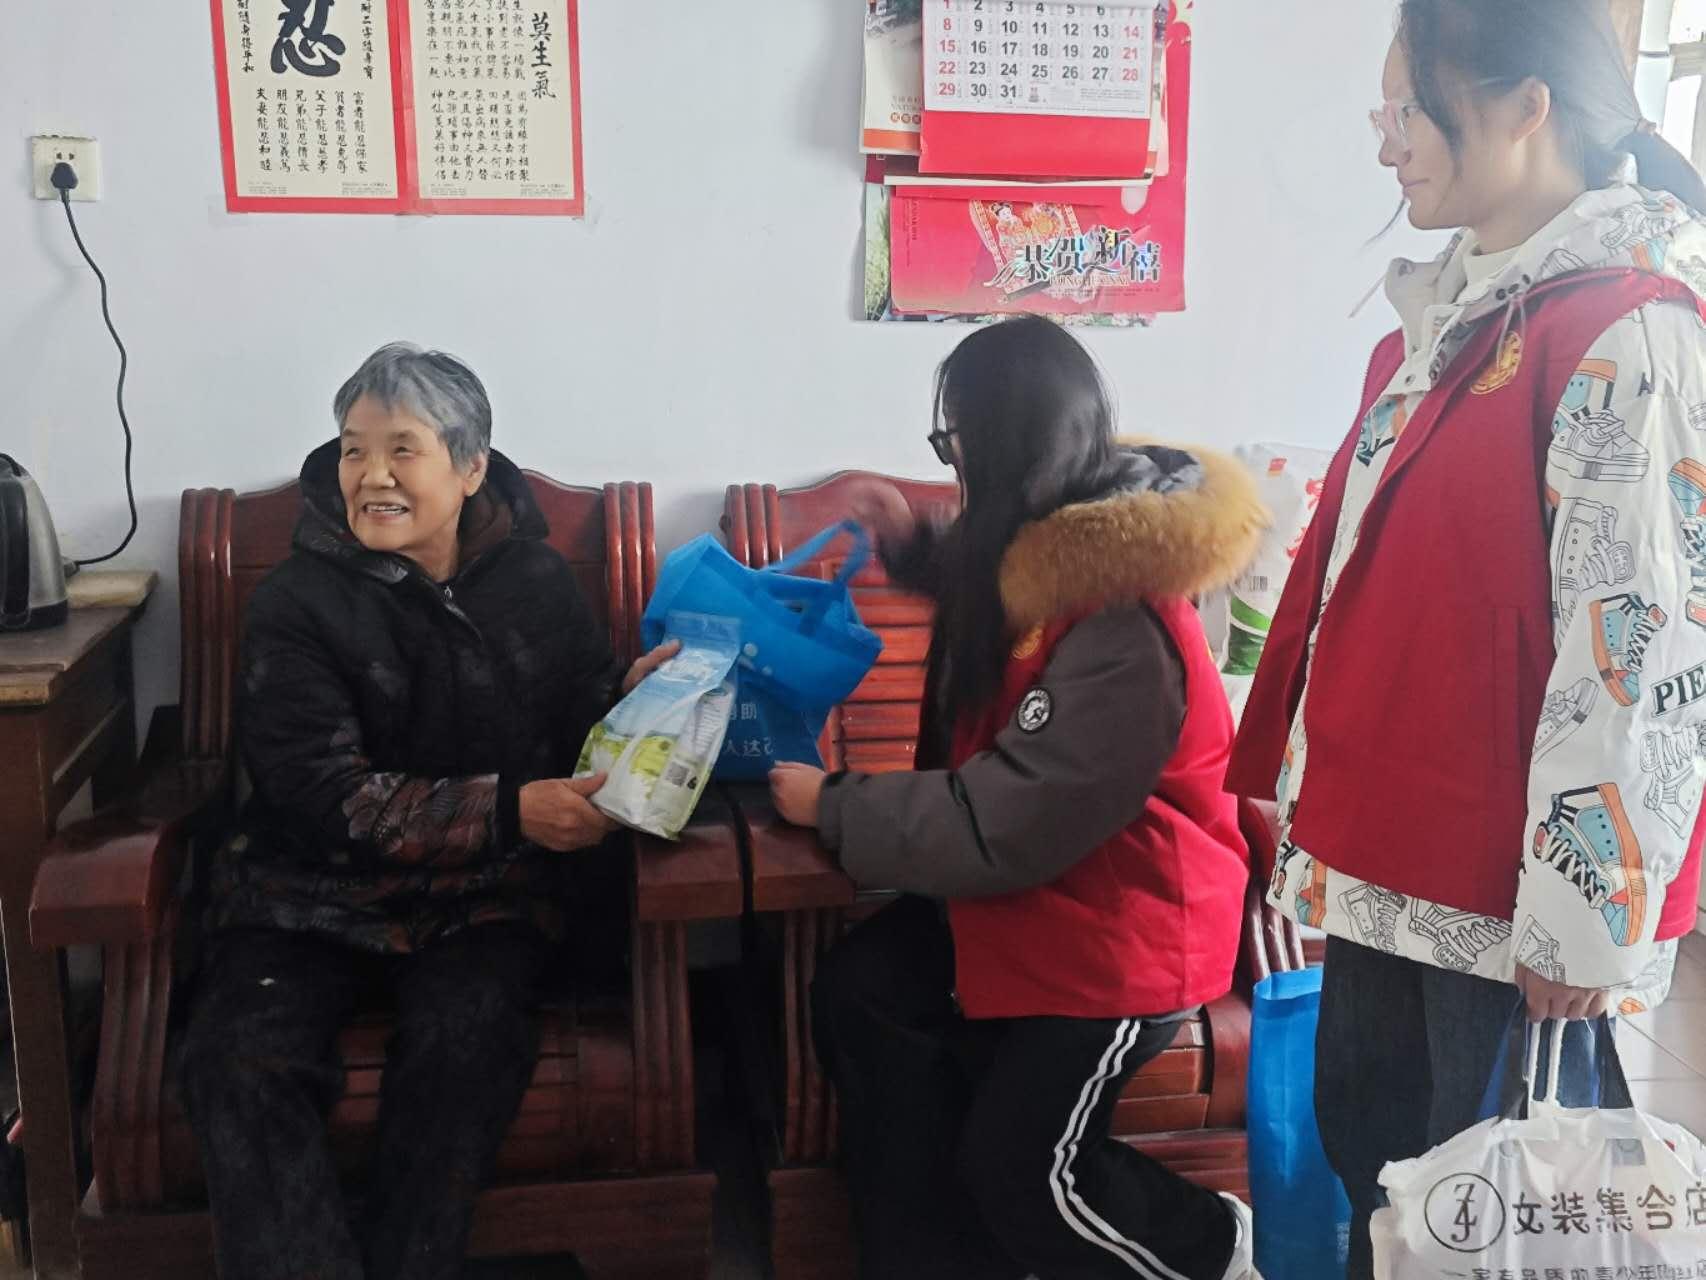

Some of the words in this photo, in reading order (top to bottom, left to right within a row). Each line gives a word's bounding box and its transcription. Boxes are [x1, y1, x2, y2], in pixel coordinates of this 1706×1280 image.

[944, 0, 949, 8] 1
[974, 0, 982, 10] 2
[1006, 1, 1013, 11] 3
[1036, 2, 1044, 12] 4
[1067, 4, 1075, 14] 5
[1097, 6, 1105, 15] 6
[944, 18, 951, 30] 8
[974, 20, 982, 31] 9
[1002, 21, 1017, 33] 10
[1033, 22, 1046, 34] 11
[1063, 24, 1078, 36] 12
[1094, 24, 1109, 37] 13
[1124, 26, 1139, 38] 14
[529, 11, 557, 100] 莫生氣
[940, 40, 955, 53] 15
[971, 41, 986, 53] 16
[1002, 42, 1017, 54] 17
[1033, 44, 1048, 56] 18
[1064, 45, 1078, 57] 19
[1093, 46, 1109, 58] 20
[1123, 47, 1137, 59] 21
[939, 61, 955, 74] 22
[969, 61, 985, 74] 23
[1001, 63, 1017, 75] 24
[1032, 65, 1048, 78] 25
[1062, 66, 1078, 79] 26
[1092, 67, 1108, 80] 27
[1123, 68, 1138, 81] 28
[939, 83, 955, 95] 29
[971, 84, 986, 96] 30
[1001, 85, 1016, 98] 31
[256, 88, 272, 171] 夫妻能忍和睦
[990, 225, 1161, 281] 恭贺新禧
[1512, 1181, 1706, 1235] 女装集合店
